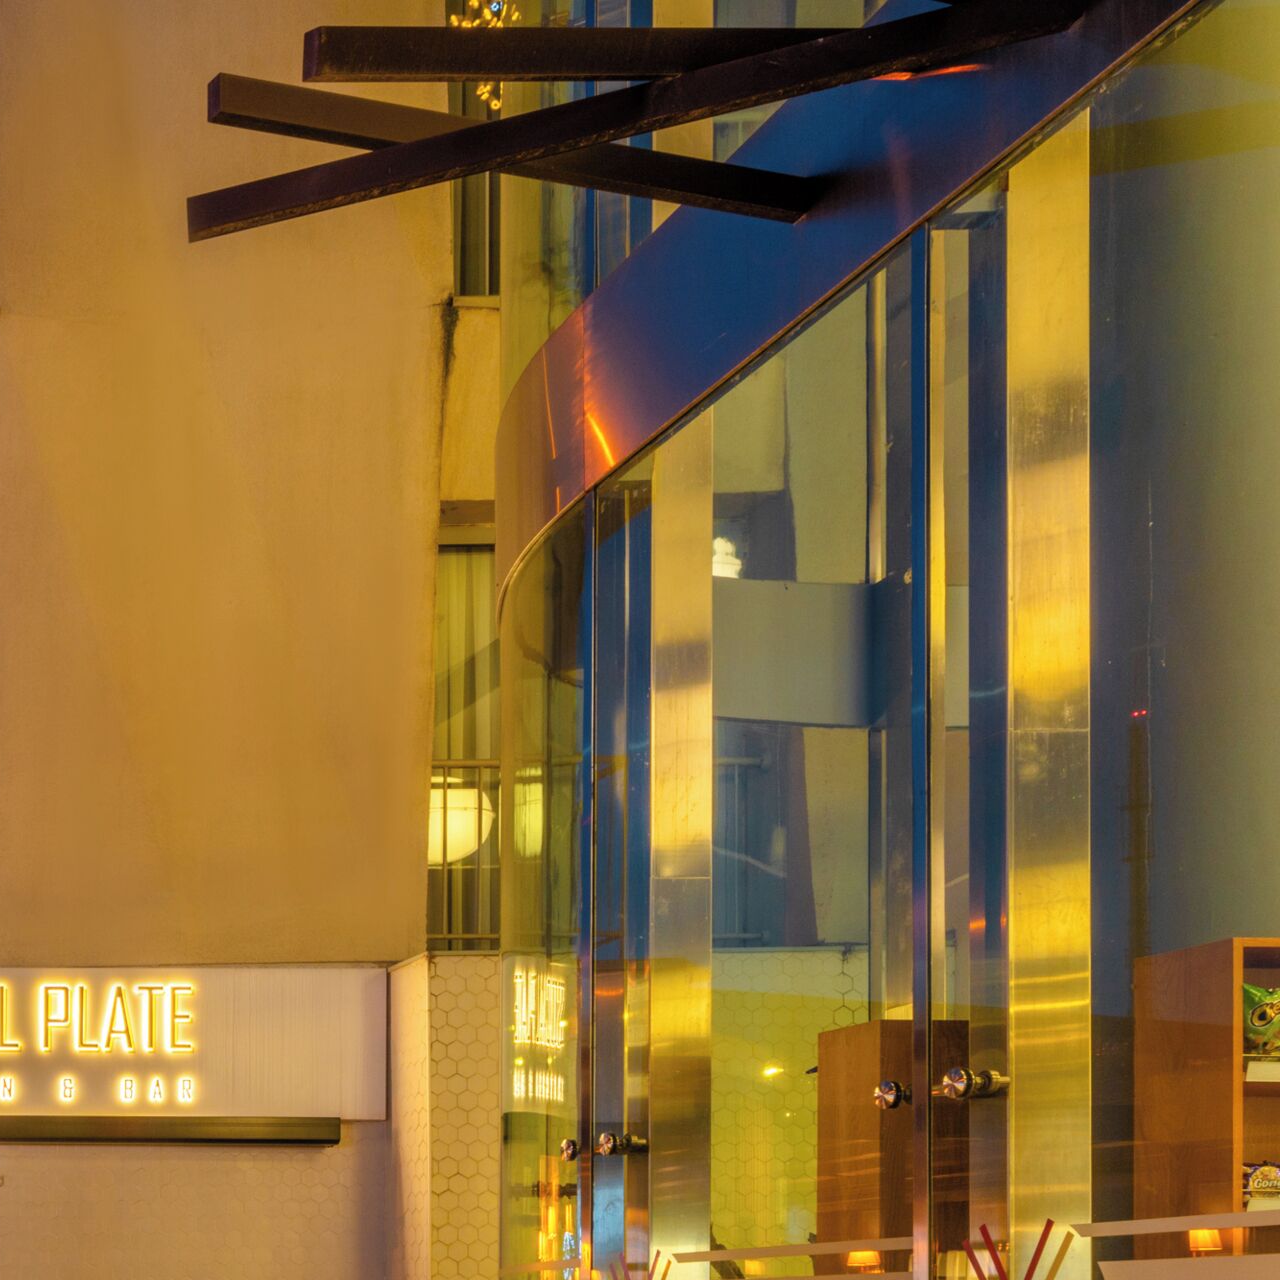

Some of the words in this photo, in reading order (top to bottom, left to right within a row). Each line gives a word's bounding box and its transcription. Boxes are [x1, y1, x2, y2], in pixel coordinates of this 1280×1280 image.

[41, 984, 195, 1051] PLATE
[61, 1076, 75, 1100] &
[121, 1077, 193, 1100] BAR
